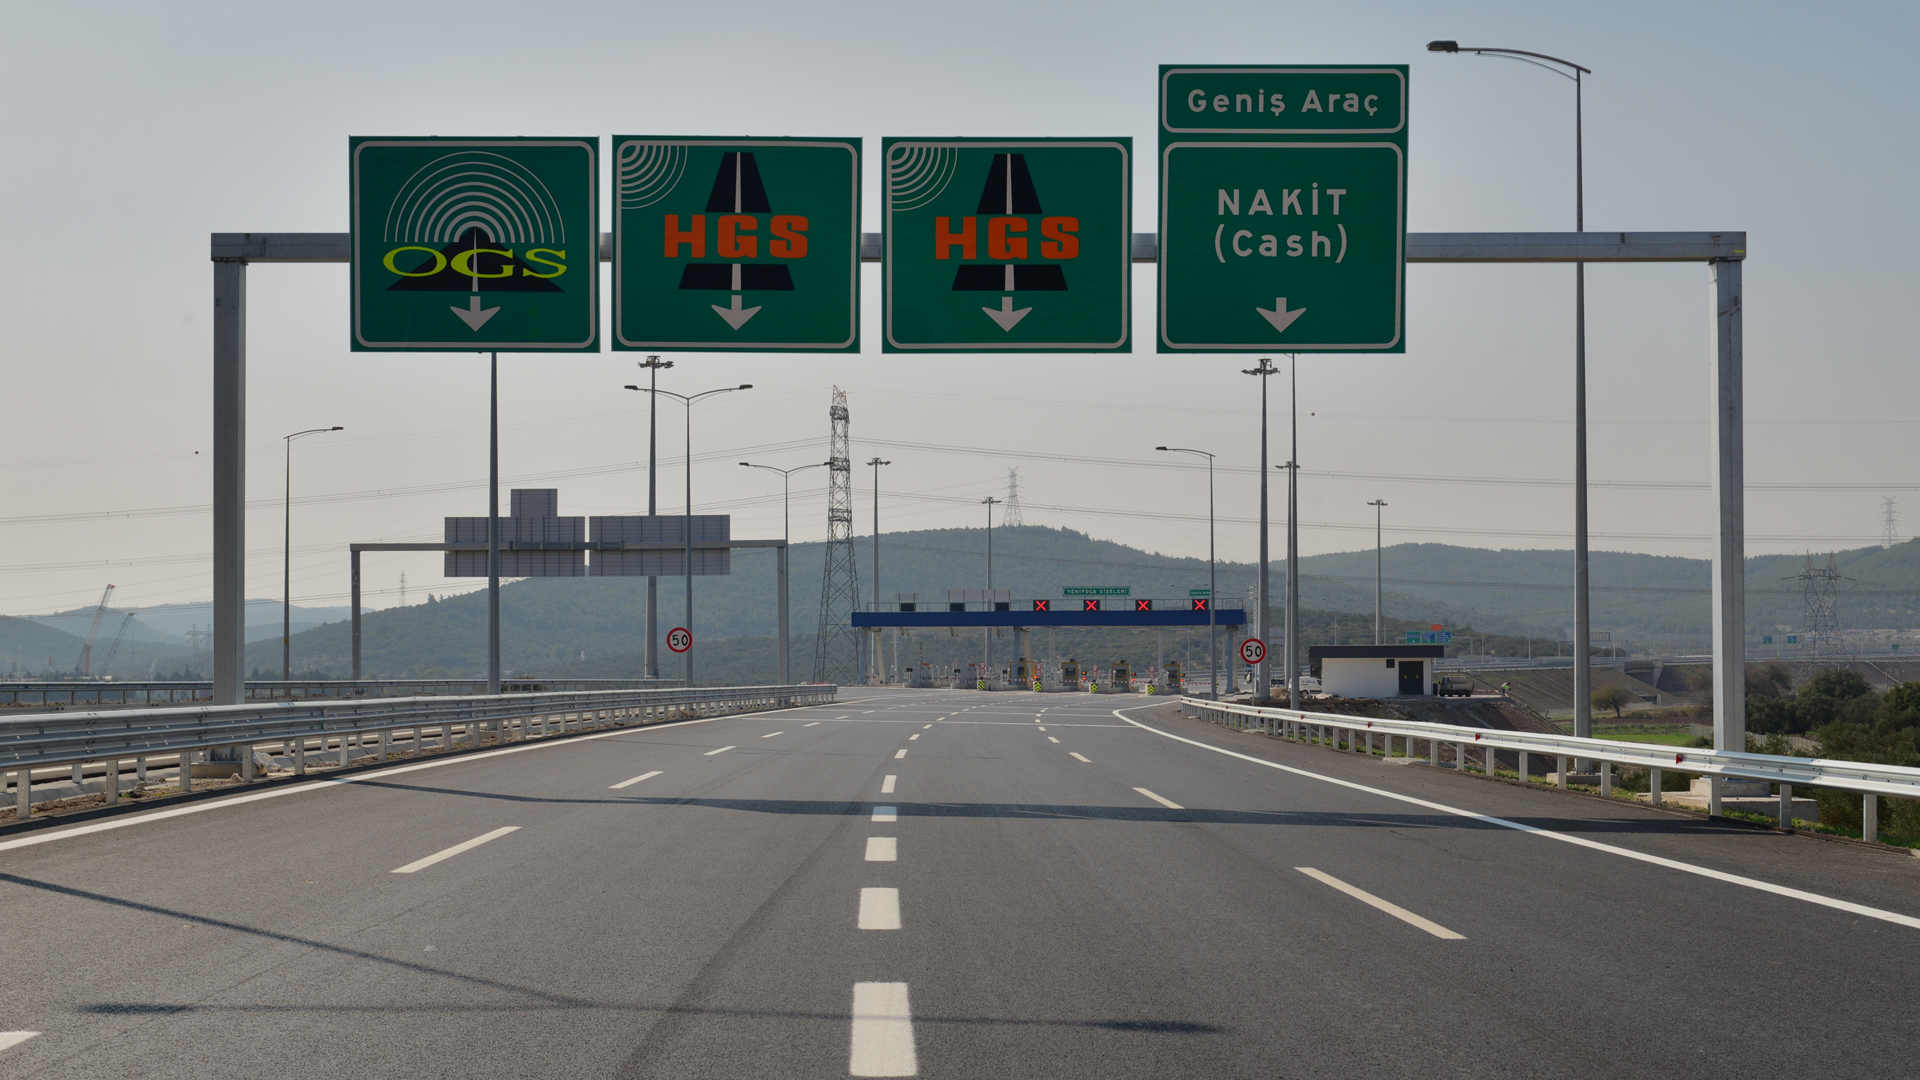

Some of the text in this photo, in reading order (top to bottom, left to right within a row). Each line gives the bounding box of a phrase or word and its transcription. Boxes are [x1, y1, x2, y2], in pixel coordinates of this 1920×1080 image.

[1188, 89, 1378, 117] Geniş Araç
[1218, 182, 1347, 216] NAKİT
[664, 213, 809, 259] HGS
[935, 216, 1079, 260] HGS
[1214, 224, 1347, 263] (Cash)
[383, 245, 567, 279] OGS
[672, 634, 688, 646] 50
[1245, 645, 1261, 657] 50
